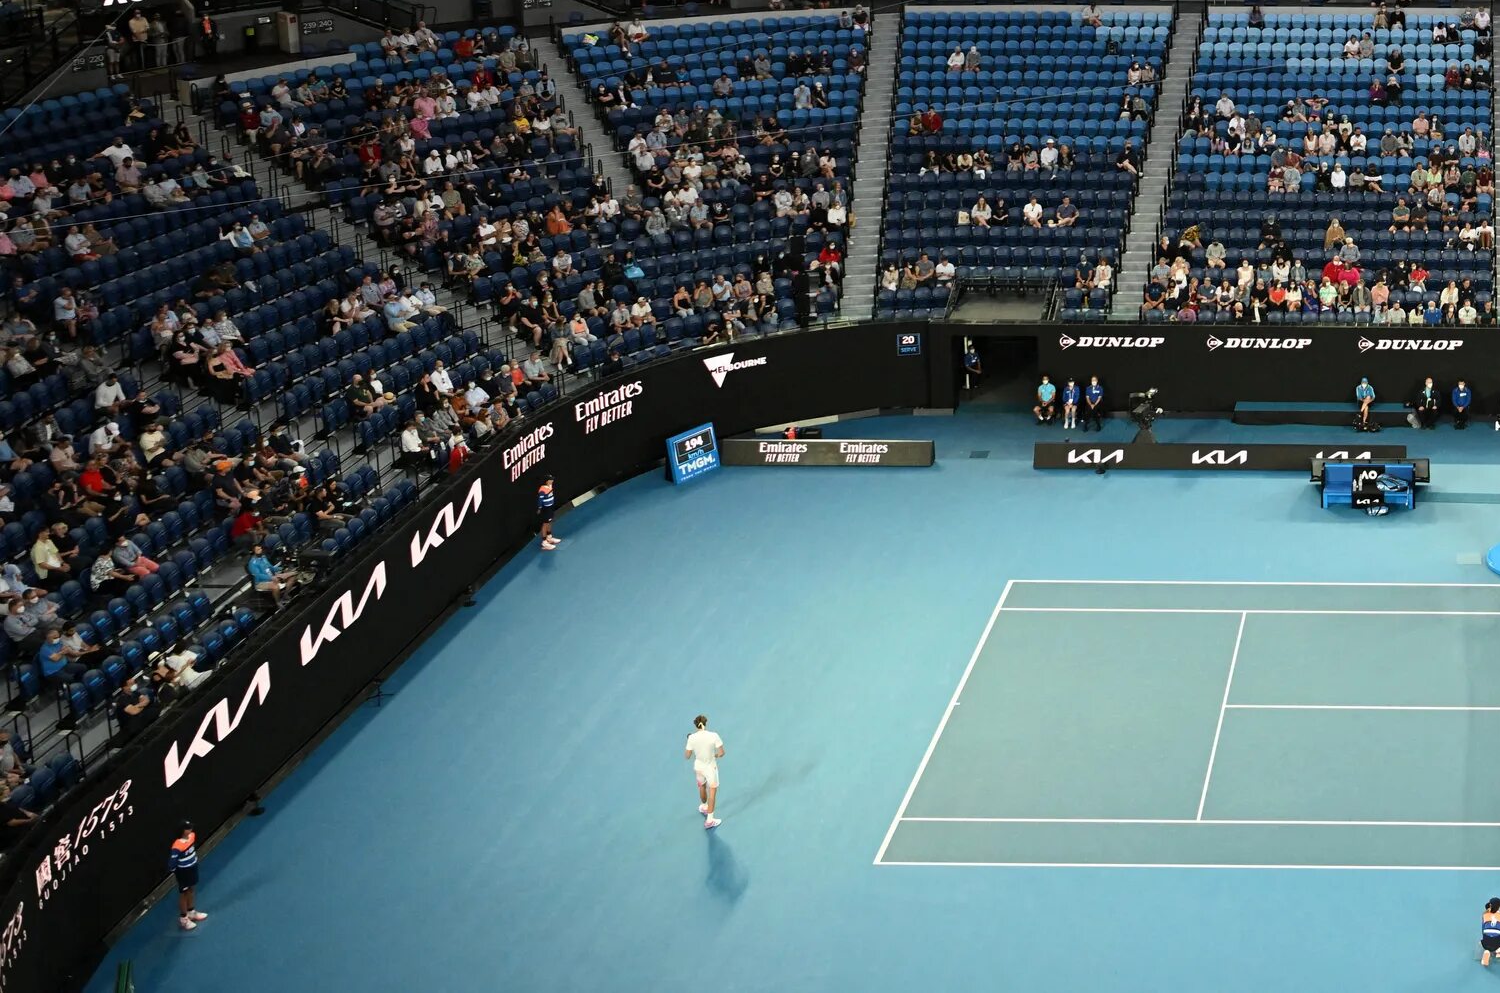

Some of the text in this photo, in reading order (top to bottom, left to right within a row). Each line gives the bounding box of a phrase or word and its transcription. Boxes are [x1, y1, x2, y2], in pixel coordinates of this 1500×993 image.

[303, 22, 316, 30] 239
[319, 19, 333, 28] 240
[89, 55, 104, 63] 220
[902, 335, 915, 344] 20
[1077, 337, 1164, 347] DUNLOP
[1224, 338, 1312, 348] DUNLOP
[1376, 340, 1463, 350] DUNLOP
[711, 357, 767, 374] MELBOURNE
[575, 380, 643, 422] Emirates
[586, 401, 633, 434] FLY BETTER
[503, 421, 554, 469] Emirates
[685, 435, 704, 451] 194
[759, 441, 807, 453] Emirates
[840, 442, 888, 454] Emirates
[765, 453, 800, 462] FLY BETTER
[846, 454, 880, 463] FLY BETTER
[1068, 450, 1123, 463] KIA
[1192, 450, 1247, 464] KIA
[511, 444, 545, 482] FLY BETTER
[1361, 470, 1377, 479] AO
[411, 478, 482, 567] KIA
[301, 561, 386, 666] KIA
[164, 661, 270, 788] KIA
[39, 806, 133, 909] GUOJIAO 1573
